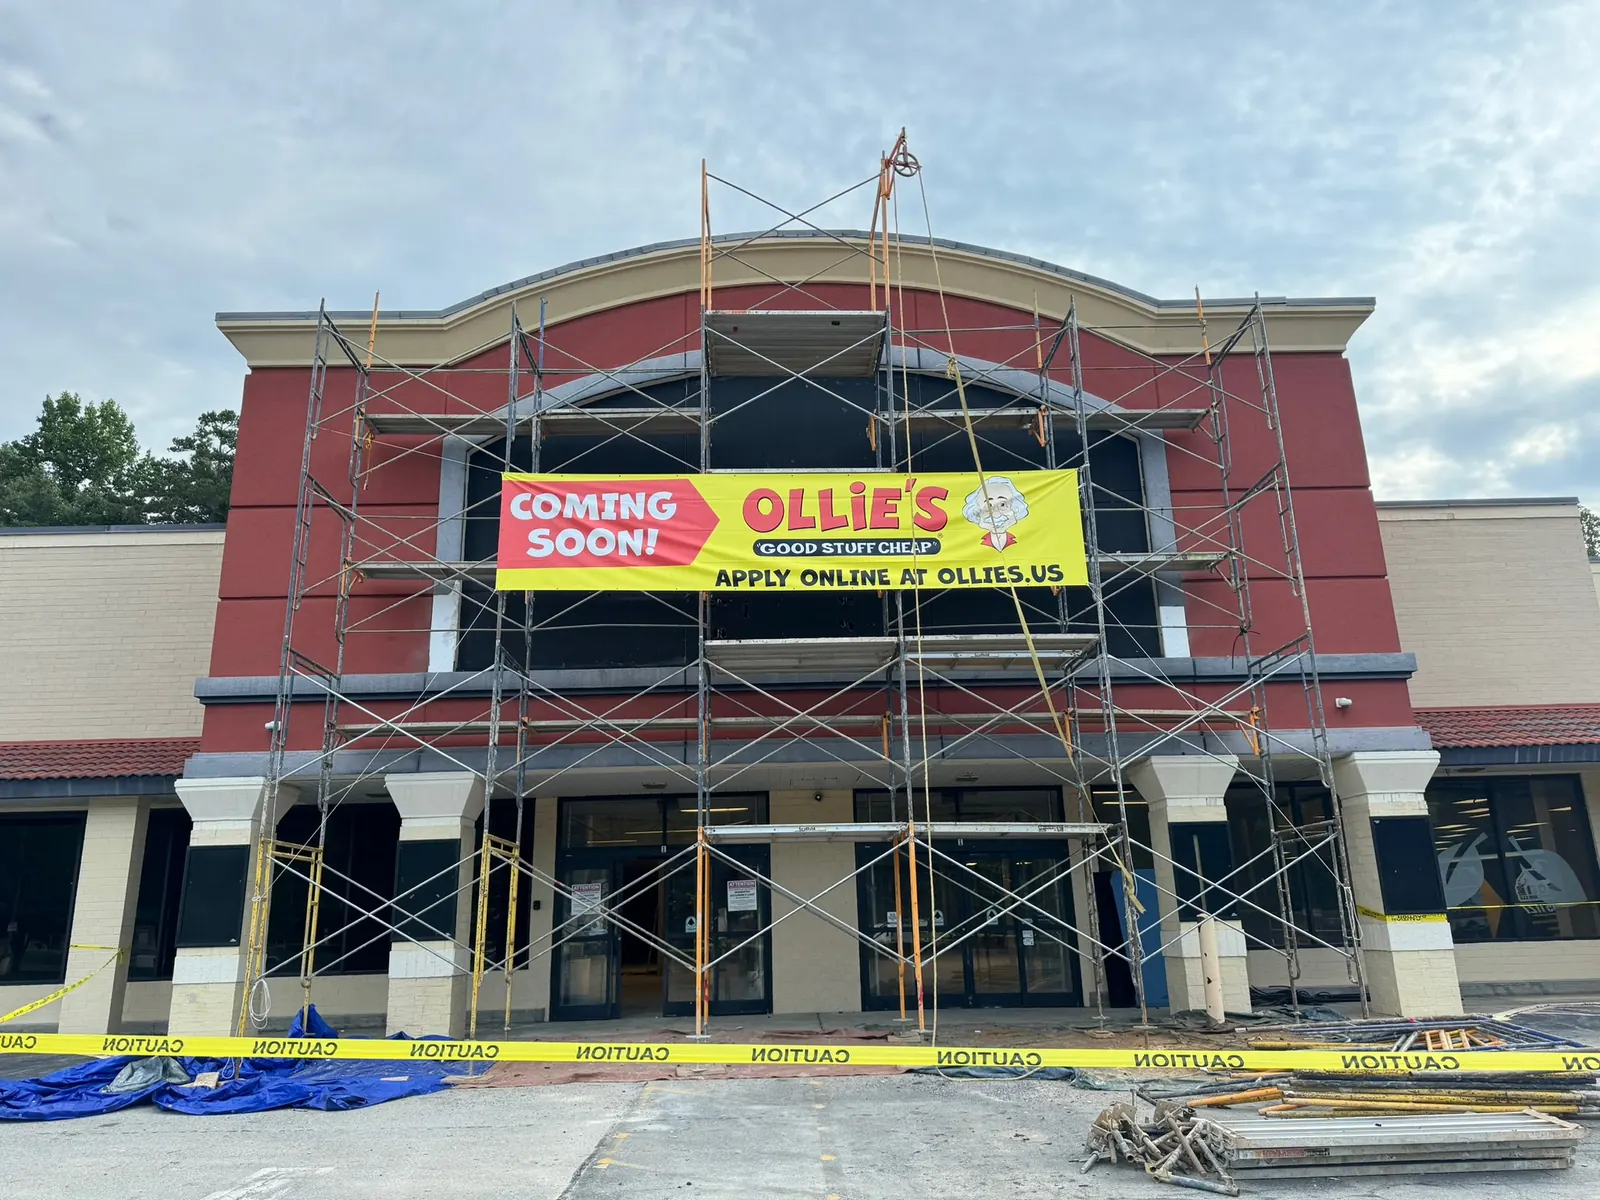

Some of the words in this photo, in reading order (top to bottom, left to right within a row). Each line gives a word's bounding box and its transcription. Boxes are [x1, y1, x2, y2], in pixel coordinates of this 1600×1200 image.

[510, 491, 677, 521] COMING
[526, 527, 660, 558] SOON!
[821, 541, 877, 555] STUFF
[715, 568, 791, 588] APPLY
[800, 568, 891, 587] ONLINE
[900, 568, 927, 586] AT
[937, 564, 1064, 585] OLLIES.US
